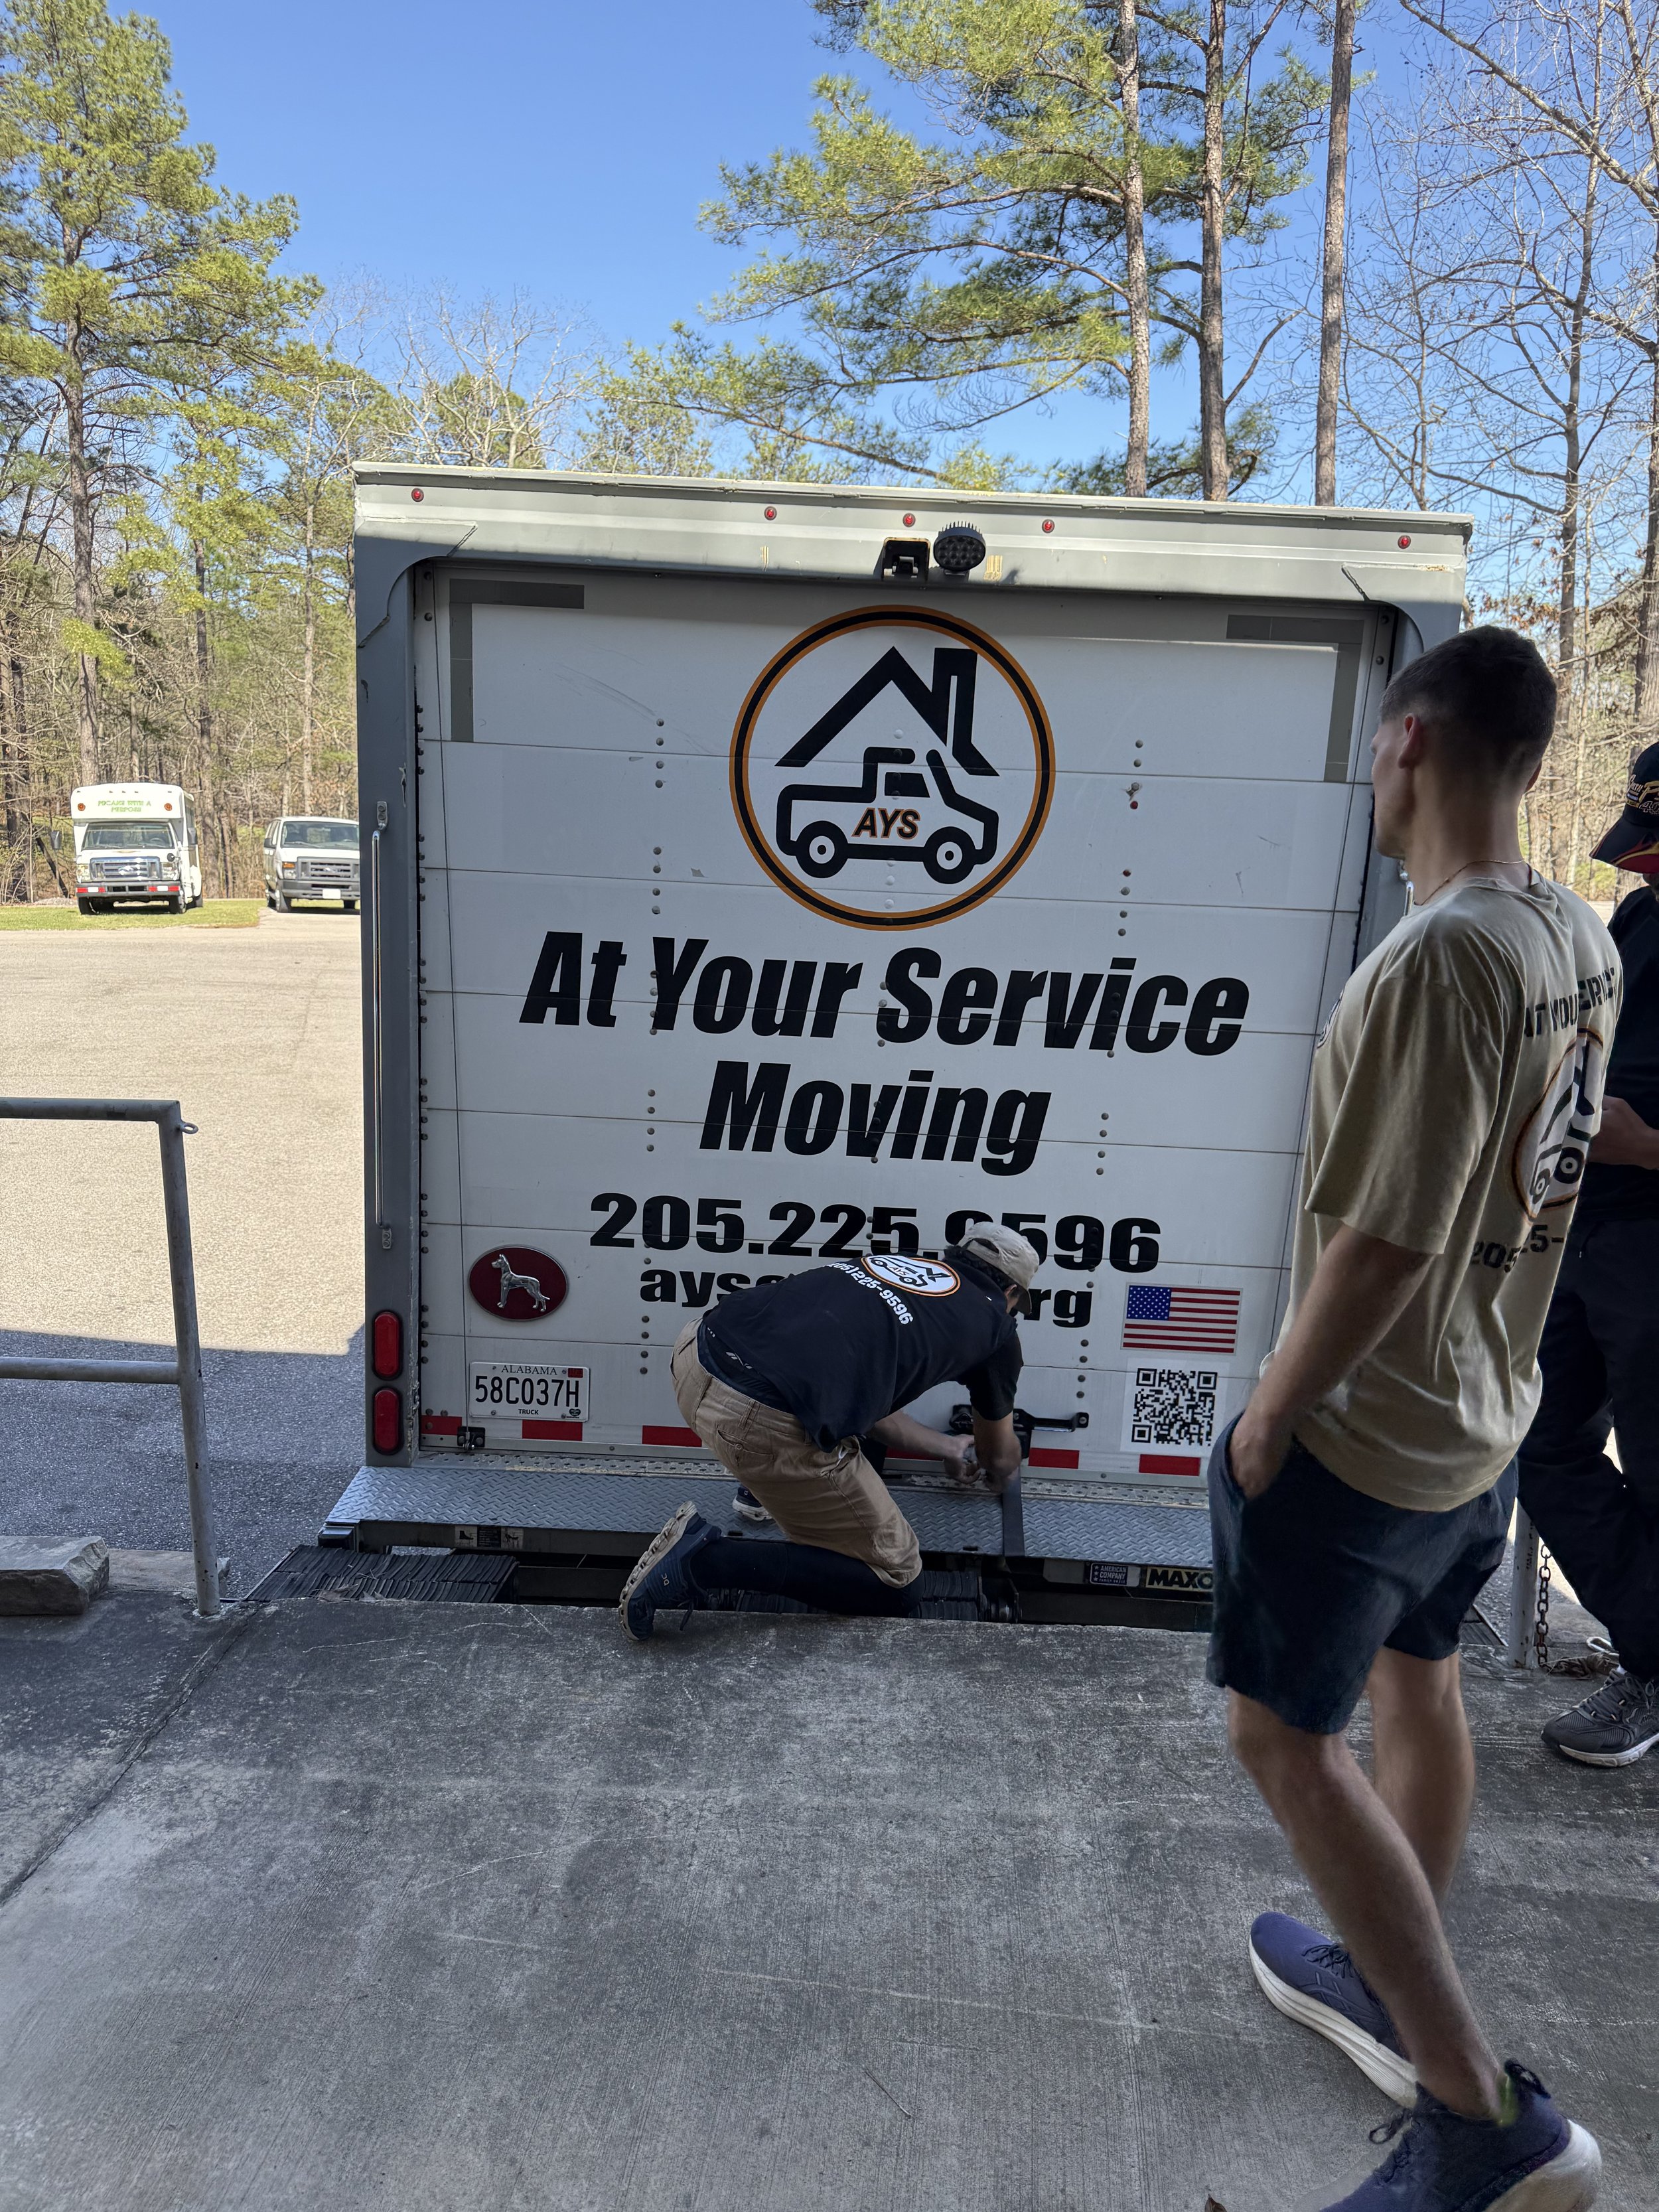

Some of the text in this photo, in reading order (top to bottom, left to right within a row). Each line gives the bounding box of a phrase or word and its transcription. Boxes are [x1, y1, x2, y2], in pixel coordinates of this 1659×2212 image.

[851, 806, 921, 840] AYS
[519, 932, 1249, 1055] At Your Service
[700, 1061, 1052, 1176] Moving
[501, 1364, 557, 1375] ALABAMA
[475, 1375, 579, 1408] 58C037H
[1100, 1571, 1126, 1580] COMPANY
